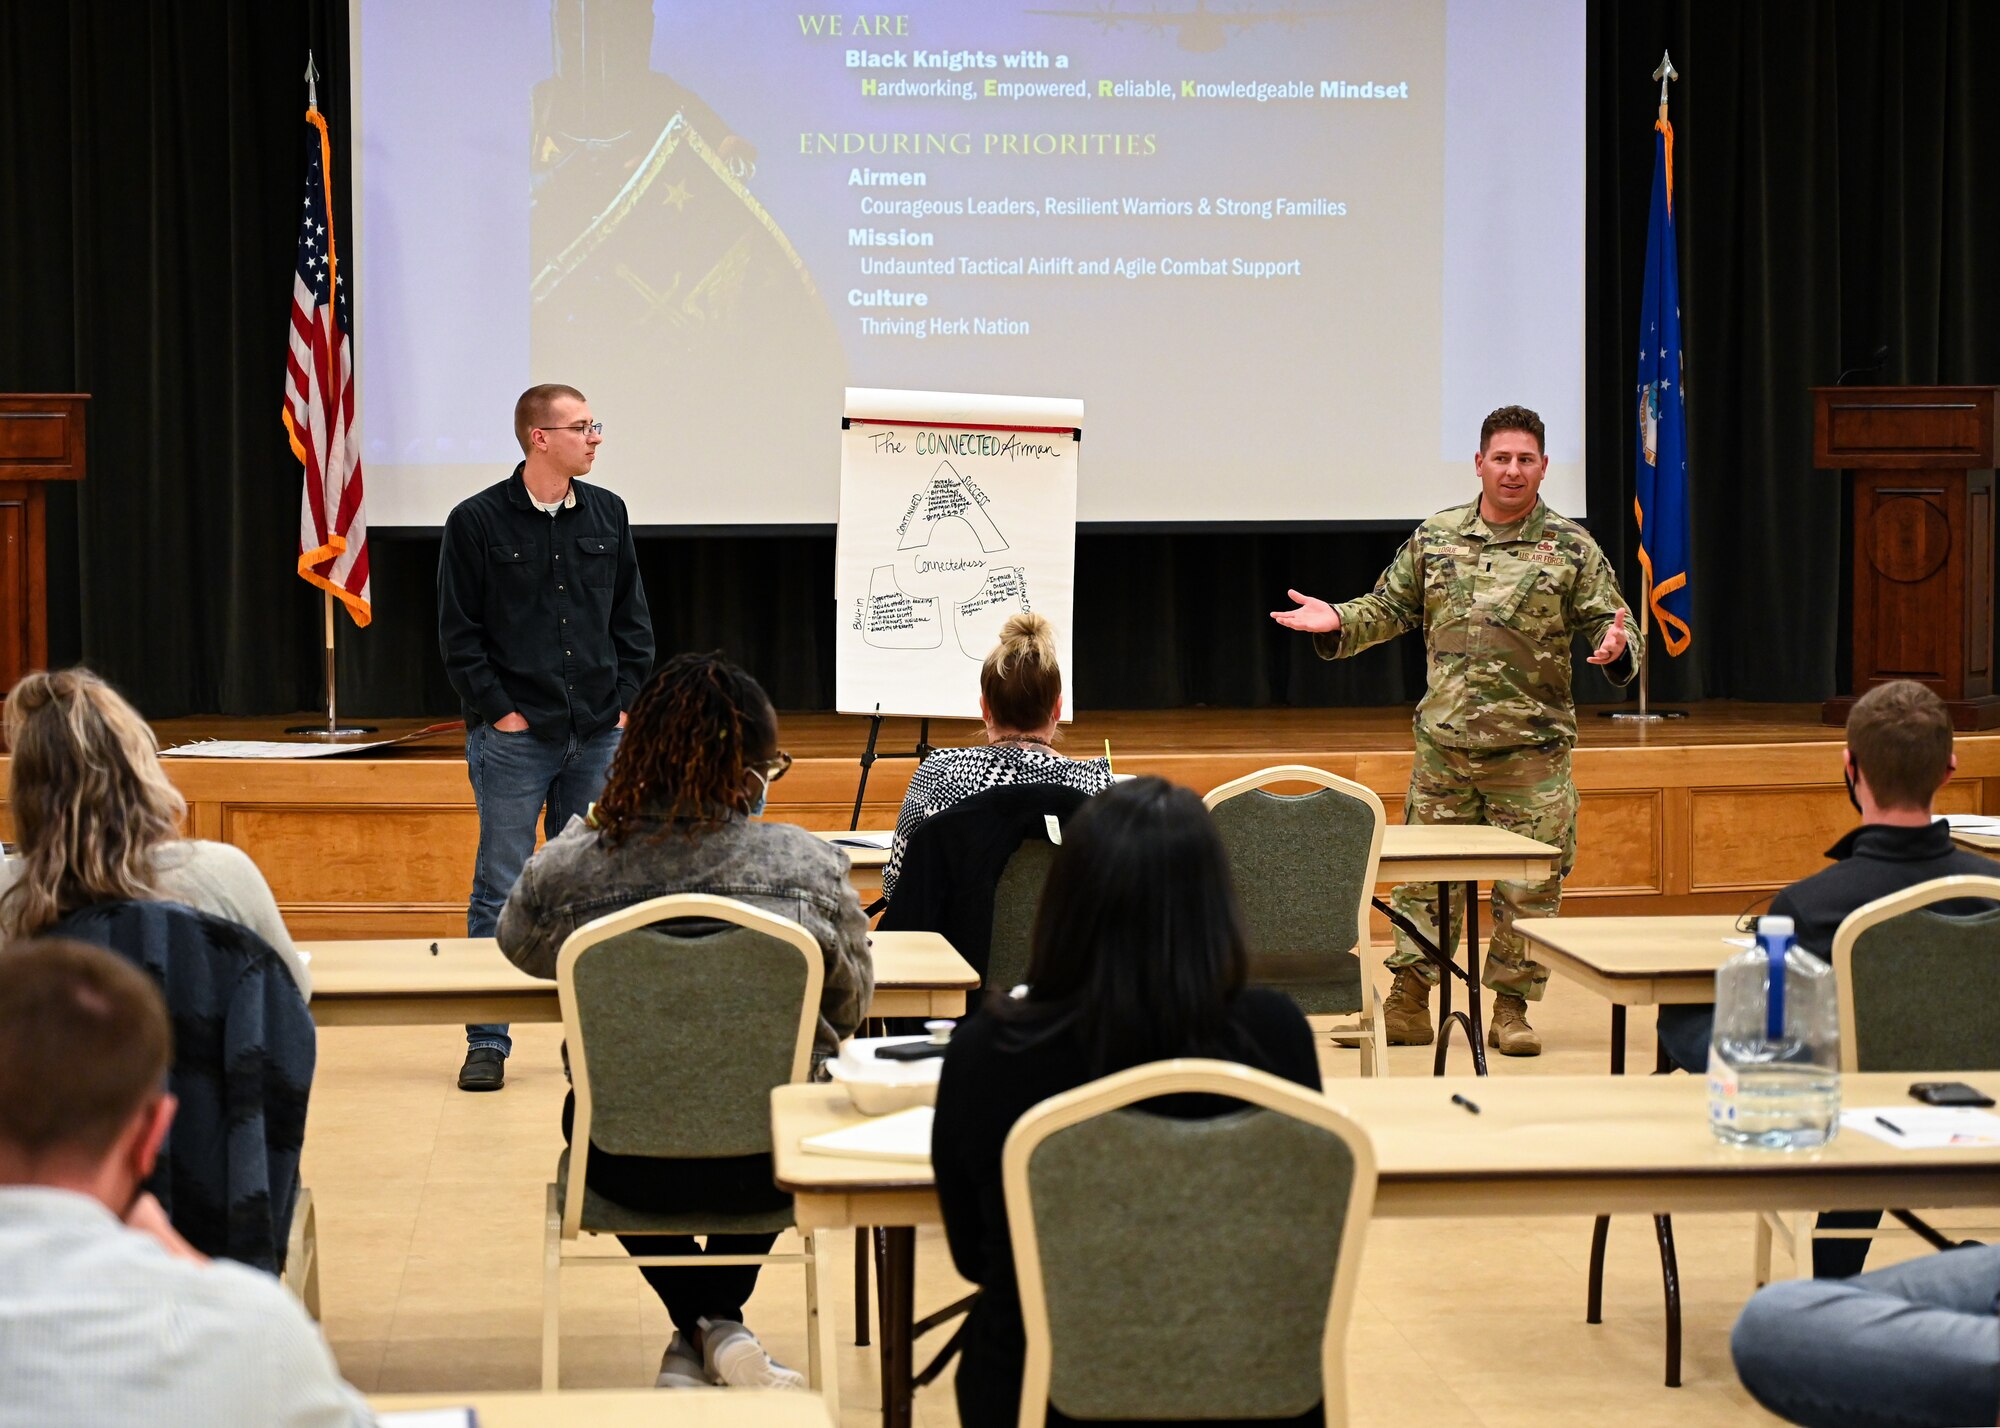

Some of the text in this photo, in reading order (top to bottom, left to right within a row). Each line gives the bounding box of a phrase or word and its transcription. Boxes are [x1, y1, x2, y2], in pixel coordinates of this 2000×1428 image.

[799, 15, 909, 37] WE ARE
[845, 49, 1069, 72] Black Knights with a
[861, 78, 1409, 102] Hardworking, Empowered, Reliable, Knowledgeable Mindset
[799, 133, 1157, 156] ENDURING PRIORITIES
[848, 168, 926, 187] Airmen
[860, 197, 1347, 219] Courageous Leaders, Resilient Warriors & Strong Families
[848, 228, 934, 247] Mission
[860, 257, 1301, 279] Undaunted Tactical Airlift and Agile Combat Support
[848, 288, 928, 308] Culture
[860, 317, 1030, 339] Thriving Herk Nation
[869, 432, 1061, 462] The CONNECTED Airman
[962, 476, 990, 506] SUCCESS
[896, 493, 922, 536] CONTINUED
[915, 555, 987, 573] Connectedness
[1544, 556, 1565, 564] FORCE
[853, 598, 865, 630] Buy-in
